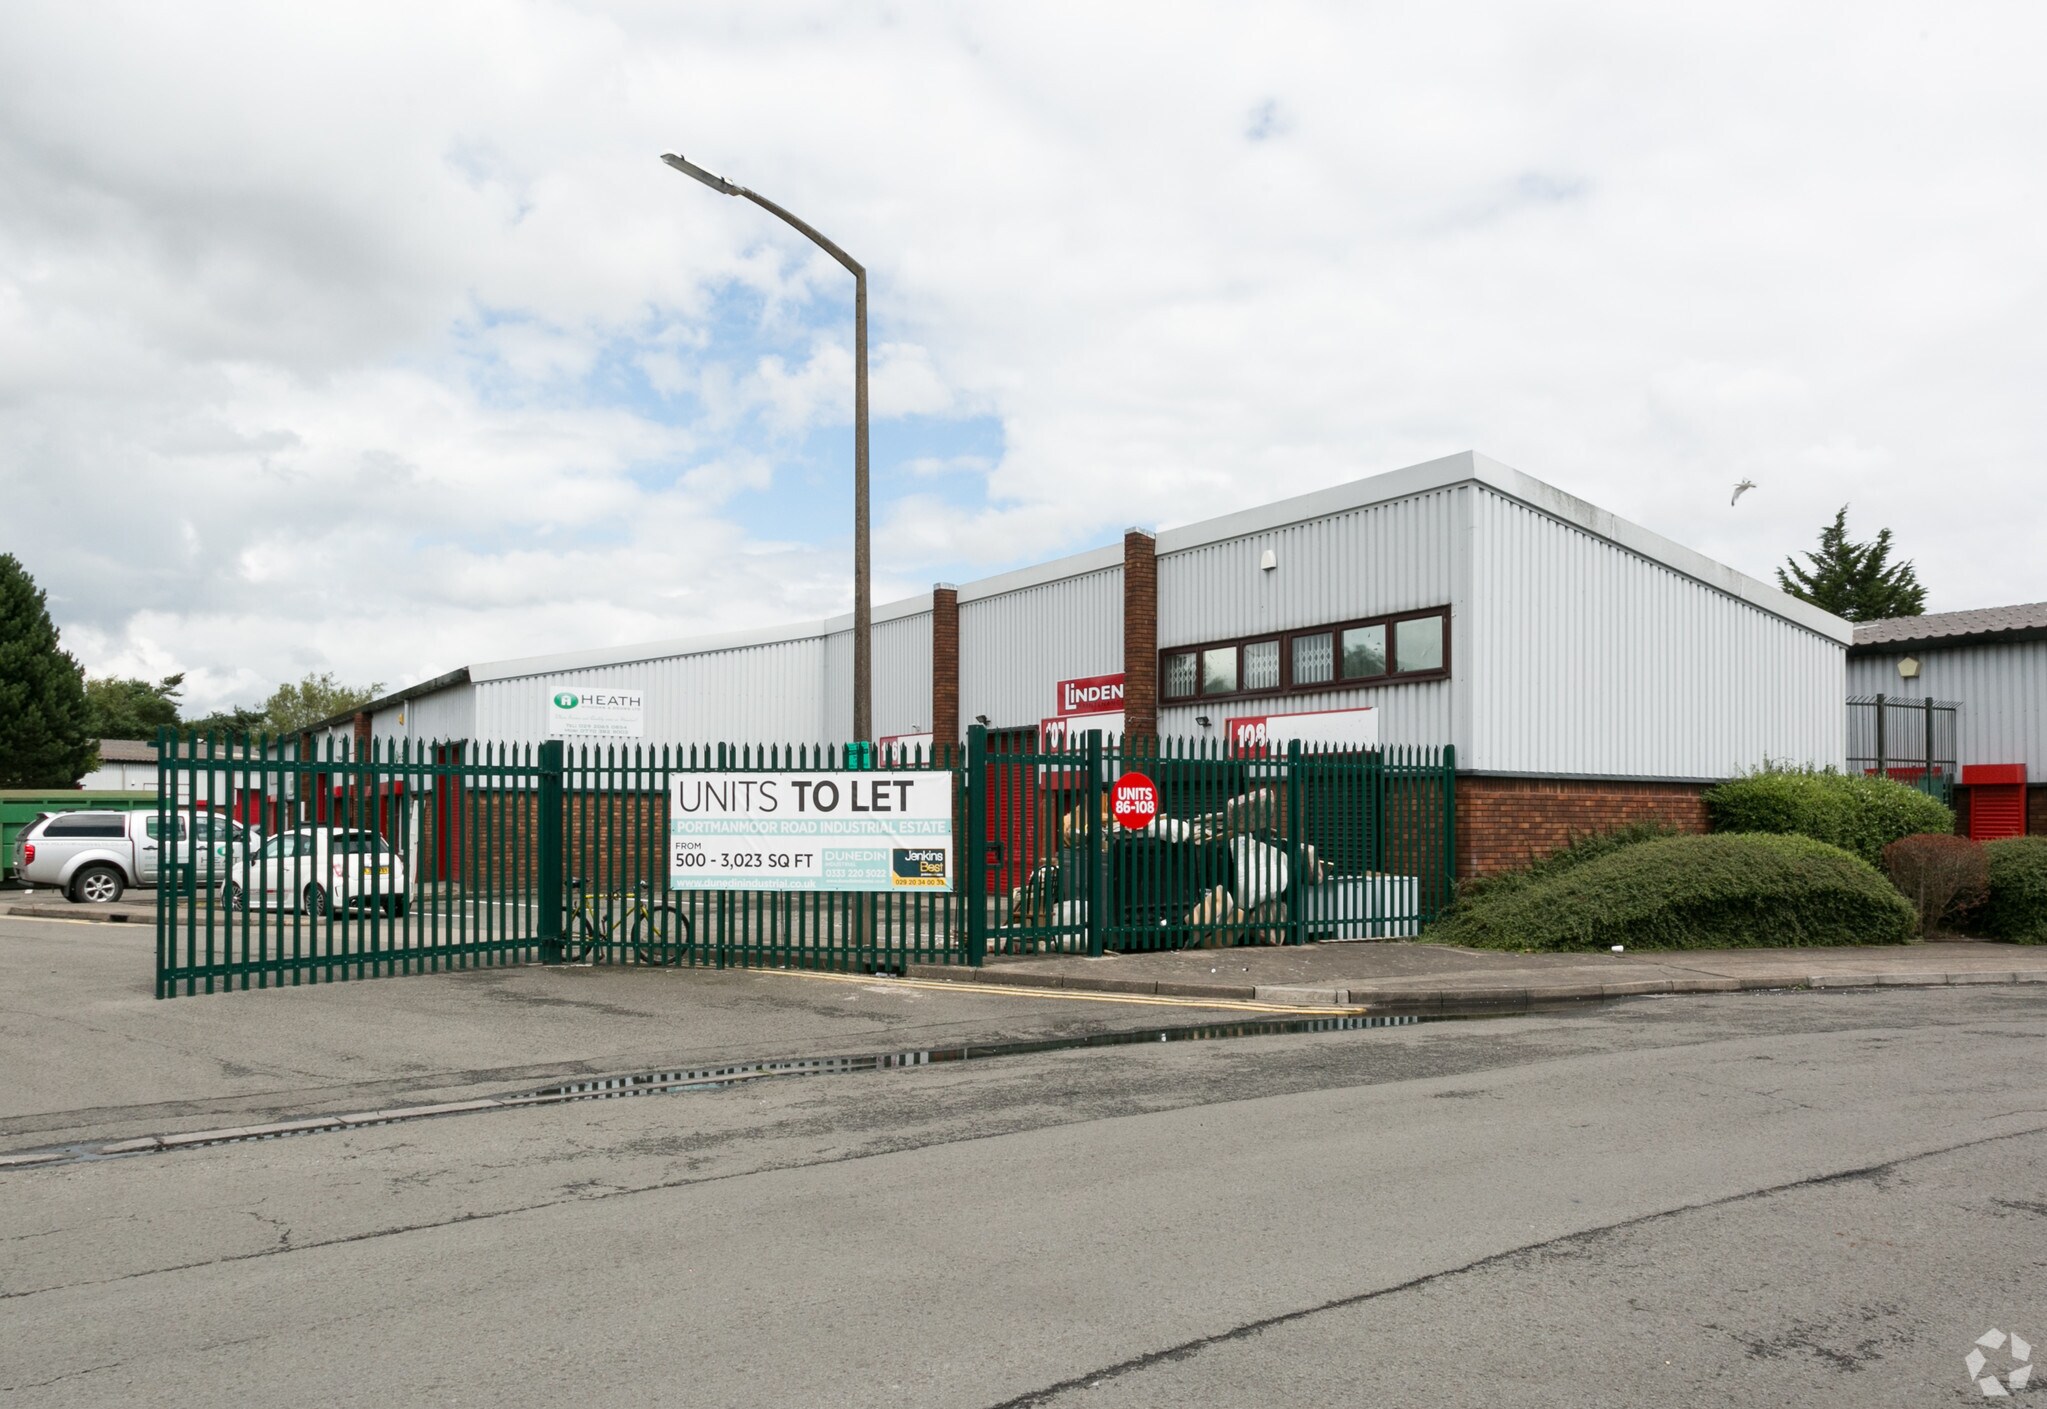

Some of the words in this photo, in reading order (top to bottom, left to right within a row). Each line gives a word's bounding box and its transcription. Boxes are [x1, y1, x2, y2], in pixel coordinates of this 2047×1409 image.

[581, 694, 641, 707] HEATH
[1237, 723, 1266, 749] 108
[881, 741, 898, 762] 16
[680, 780, 778, 812] UNITS
[791, 780, 839, 812] TO
[851, 780, 914, 812] LET
[1117, 787, 1153, 801] UNITS
[1115, 801, 1155, 814] 86-108
[677, 821, 778, 834] PORTMANMOOR
[780, 821, 817, 834] ROAD
[820, 821, 897, 833] INDUSTRIAL
[900, 821, 946, 833] ESTATE
[675, 842, 702, 850] FROM
[676, 853, 706, 867] 500
[720, 853, 762, 870] 3,023
[768, 853, 790, 868] SQ
[794, 853, 814, 868] FT
[824, 850, 887, 861] DUNEDIN
[904, 850, 944, 861] Jenkins
[920, 861, 944, 872] Best
[825, 869, 845, 878] 0333
[847, 869, 864, 878] 220
[865, 869, 886, 878] 5022
[676, 878, 816, 889] www.dunedinindustrial.co.uk
